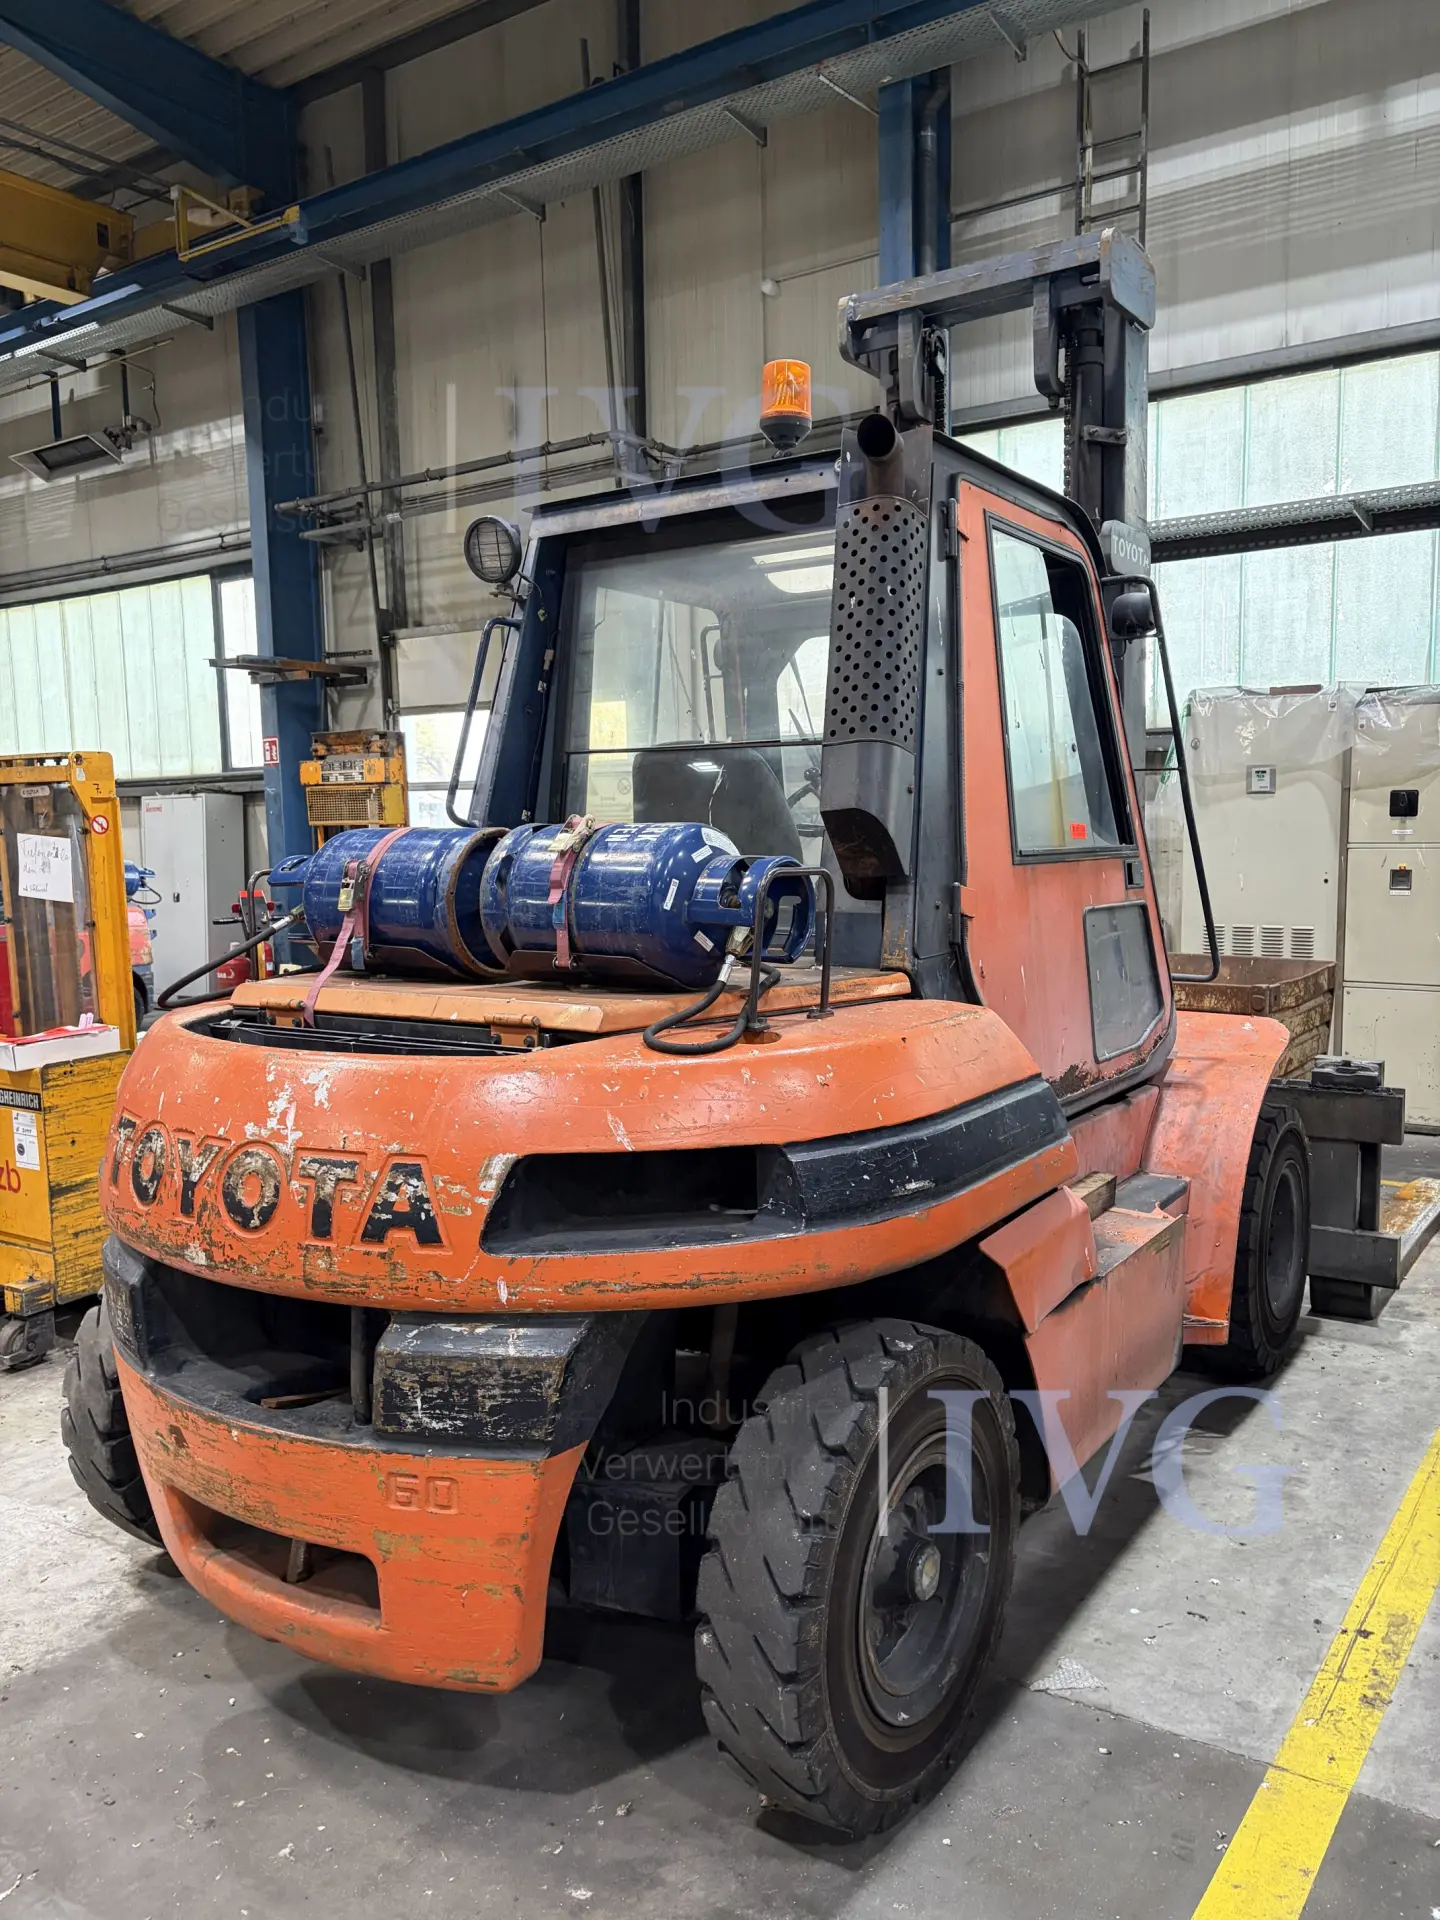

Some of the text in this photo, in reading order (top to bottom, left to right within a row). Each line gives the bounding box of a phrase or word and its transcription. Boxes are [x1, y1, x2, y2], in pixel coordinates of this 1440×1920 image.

[1112, 534, 1150, 569] TOYOTA
[110, 1112, 446, 1247] TOYOTA
[387, 1471, 459, 1515] 60
